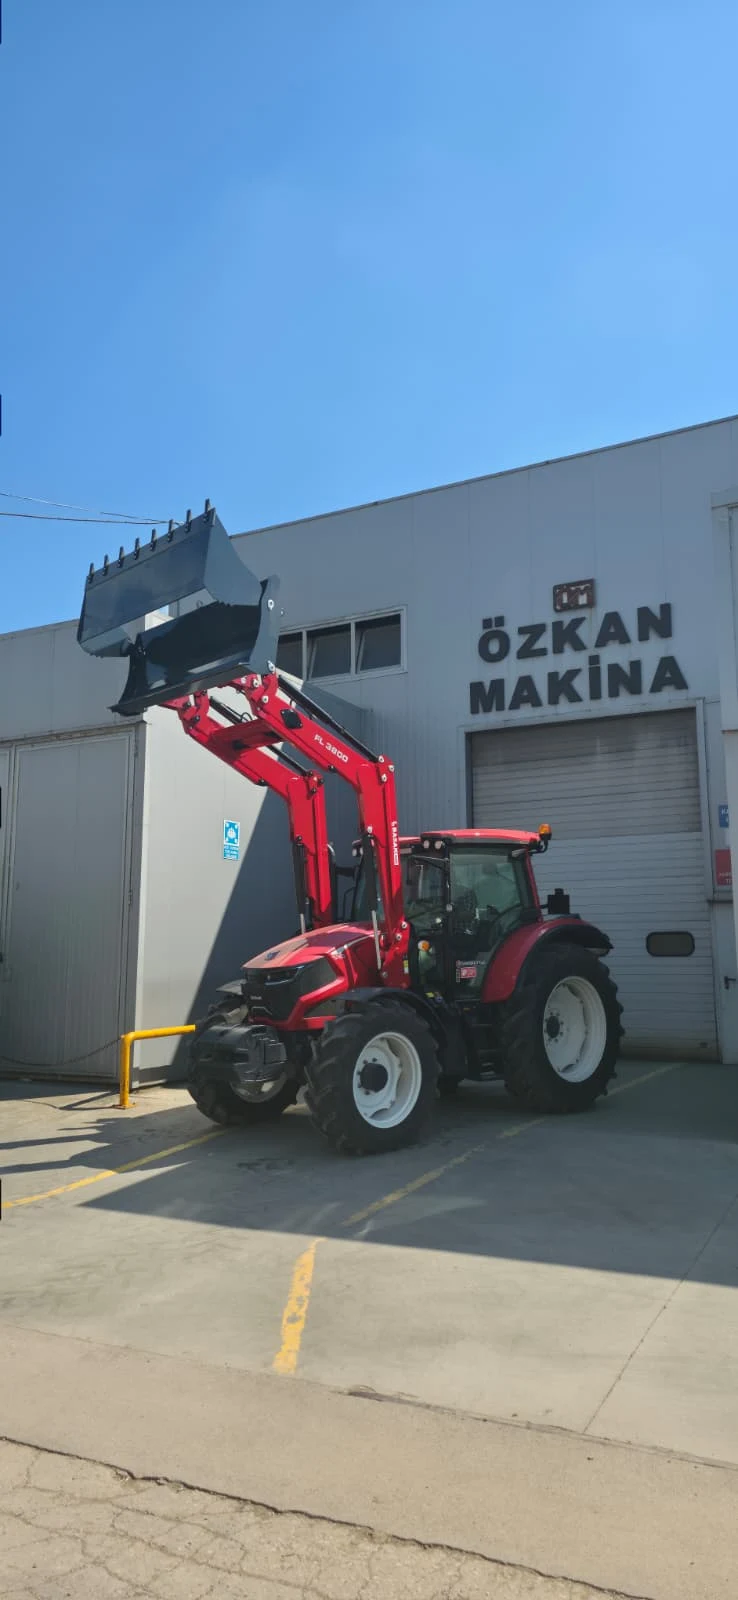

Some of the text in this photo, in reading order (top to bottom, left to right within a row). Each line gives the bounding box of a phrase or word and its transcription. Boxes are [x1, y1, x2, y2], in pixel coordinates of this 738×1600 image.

[478, 603, 672, 663] ÖZKAN
[470, 655, 689, 715] MAKİNA
[314, 734, 349, 763] FL 3800
